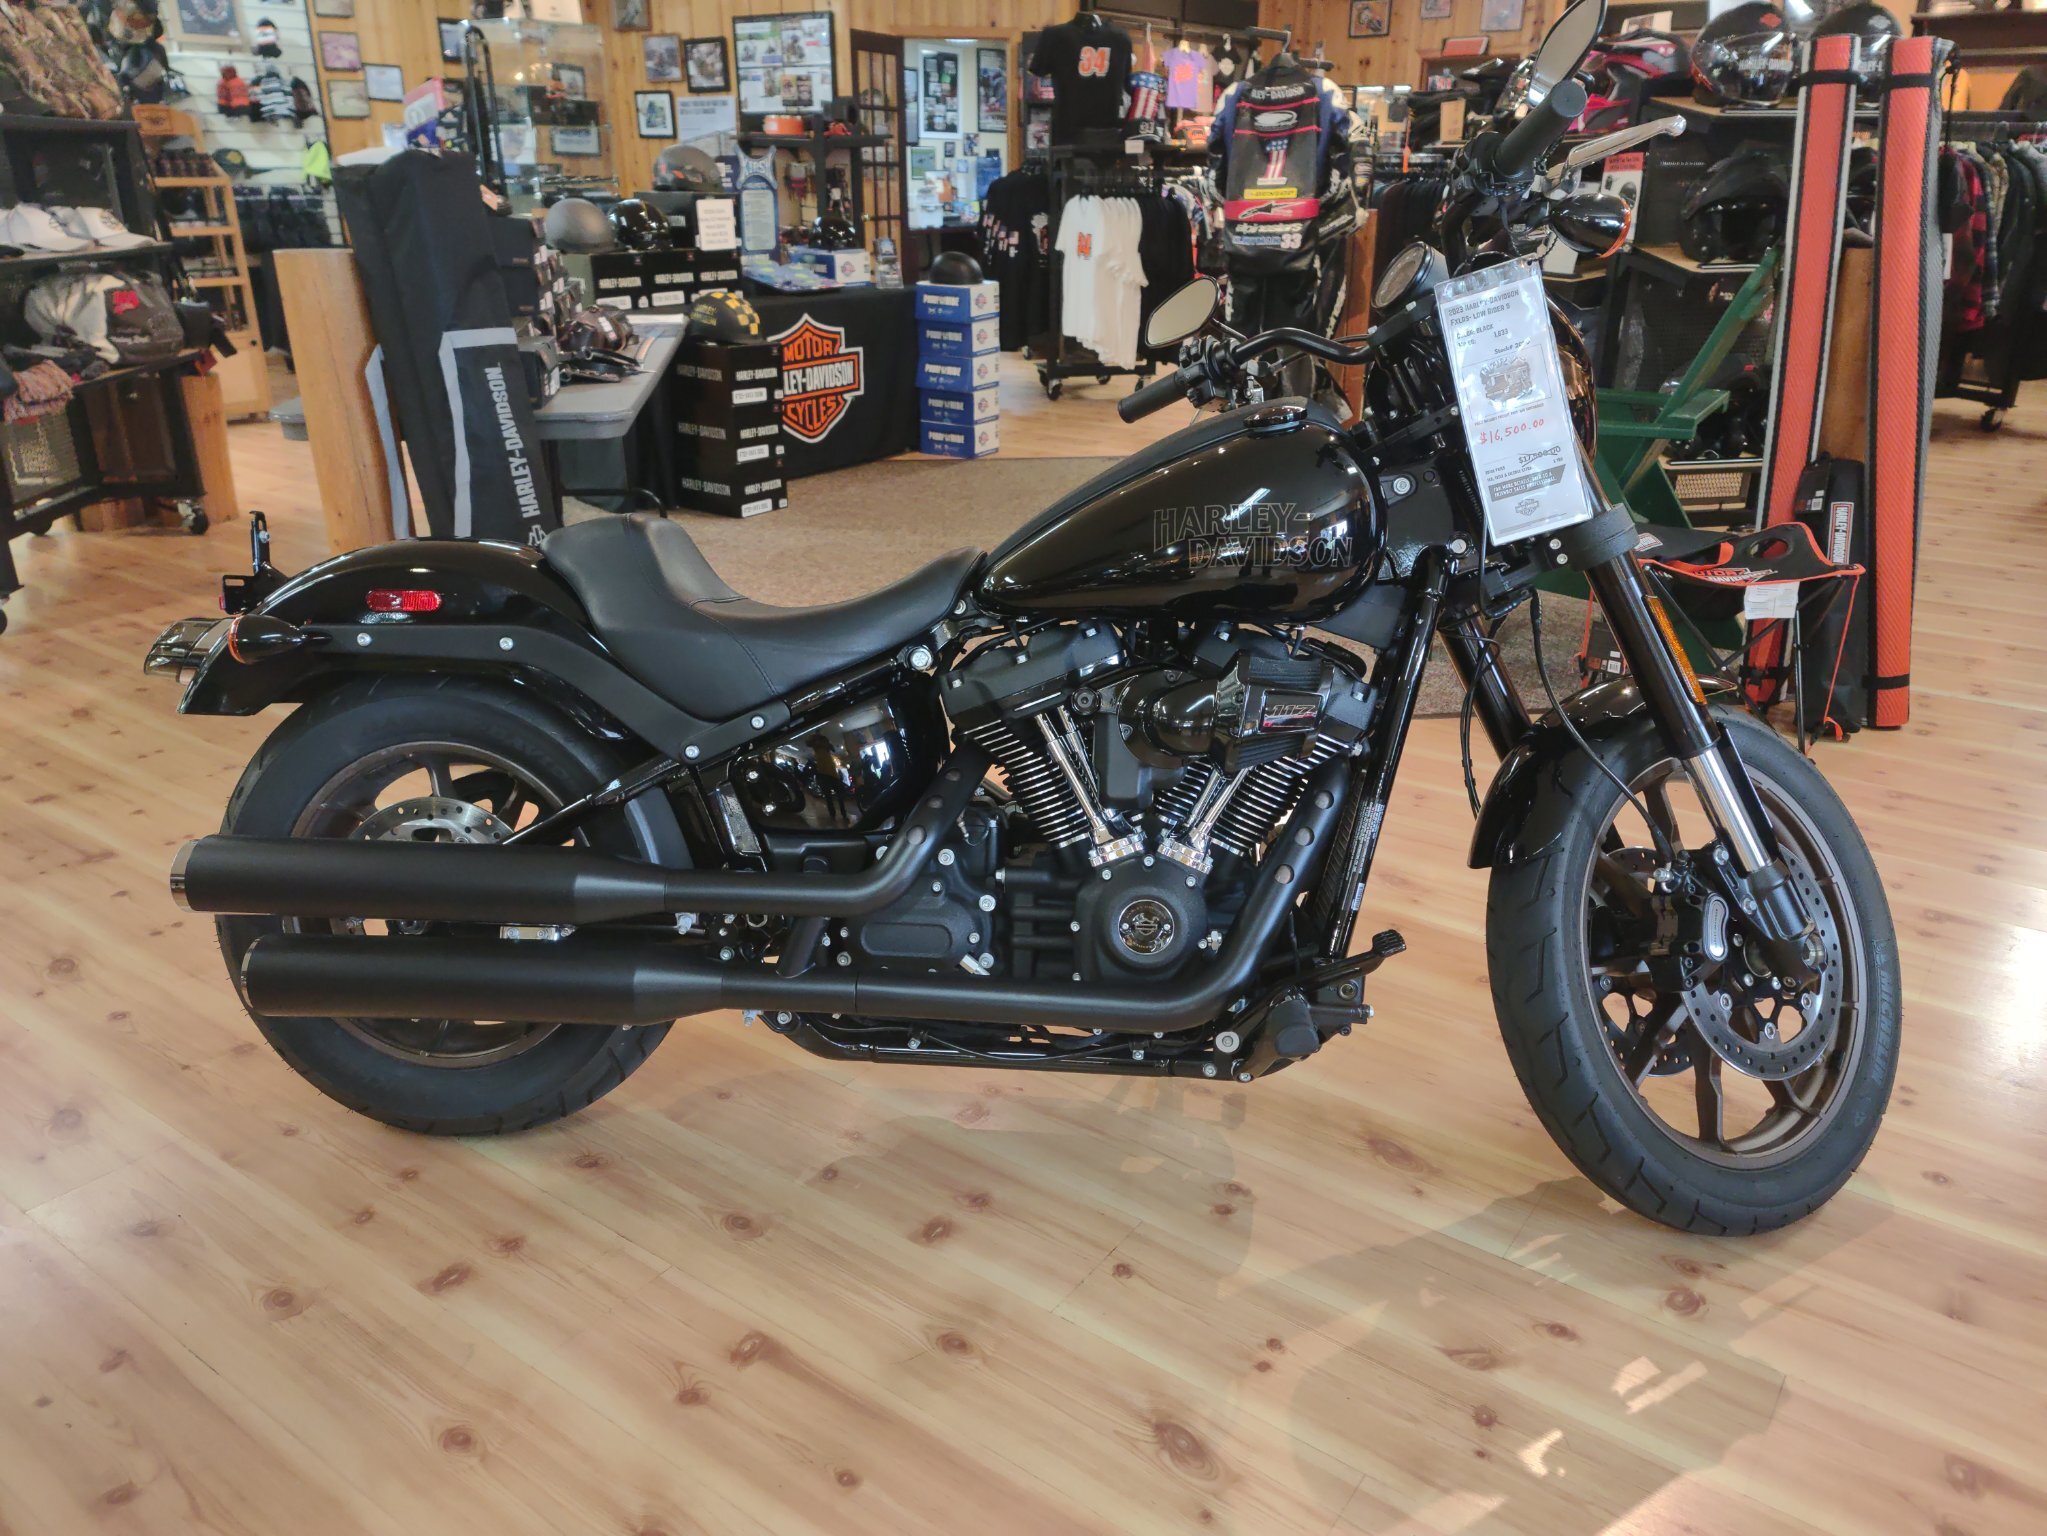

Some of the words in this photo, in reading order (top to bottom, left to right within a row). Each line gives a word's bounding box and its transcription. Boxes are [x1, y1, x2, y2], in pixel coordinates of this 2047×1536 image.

[1078, 45, 1111, 77] 34
[1280, 233, 1302, 249] 33
[1449, 306, 1464, 316] 2023
[1473, 310, 1486, 320] LOW
[1487, 304, 1505, 316] RIDER
[1476, 324, 1494, 335] BLACK
[783, 333, 833, 363] MOTOR
[783, 360, 854, 396] LEY-DAVIDSON
[787, 395, 838, 431] CYCLES
[485, 366, 541, 518] HARLEY-DAVIDSON
[1480, 418, 1544, 445] $16,500.00
[1189, 536, 1352, 569] DAVIDSON
[1273, 705, 1316, 717] 117
[1871, 969, 1894, 1087] MICHELIN
